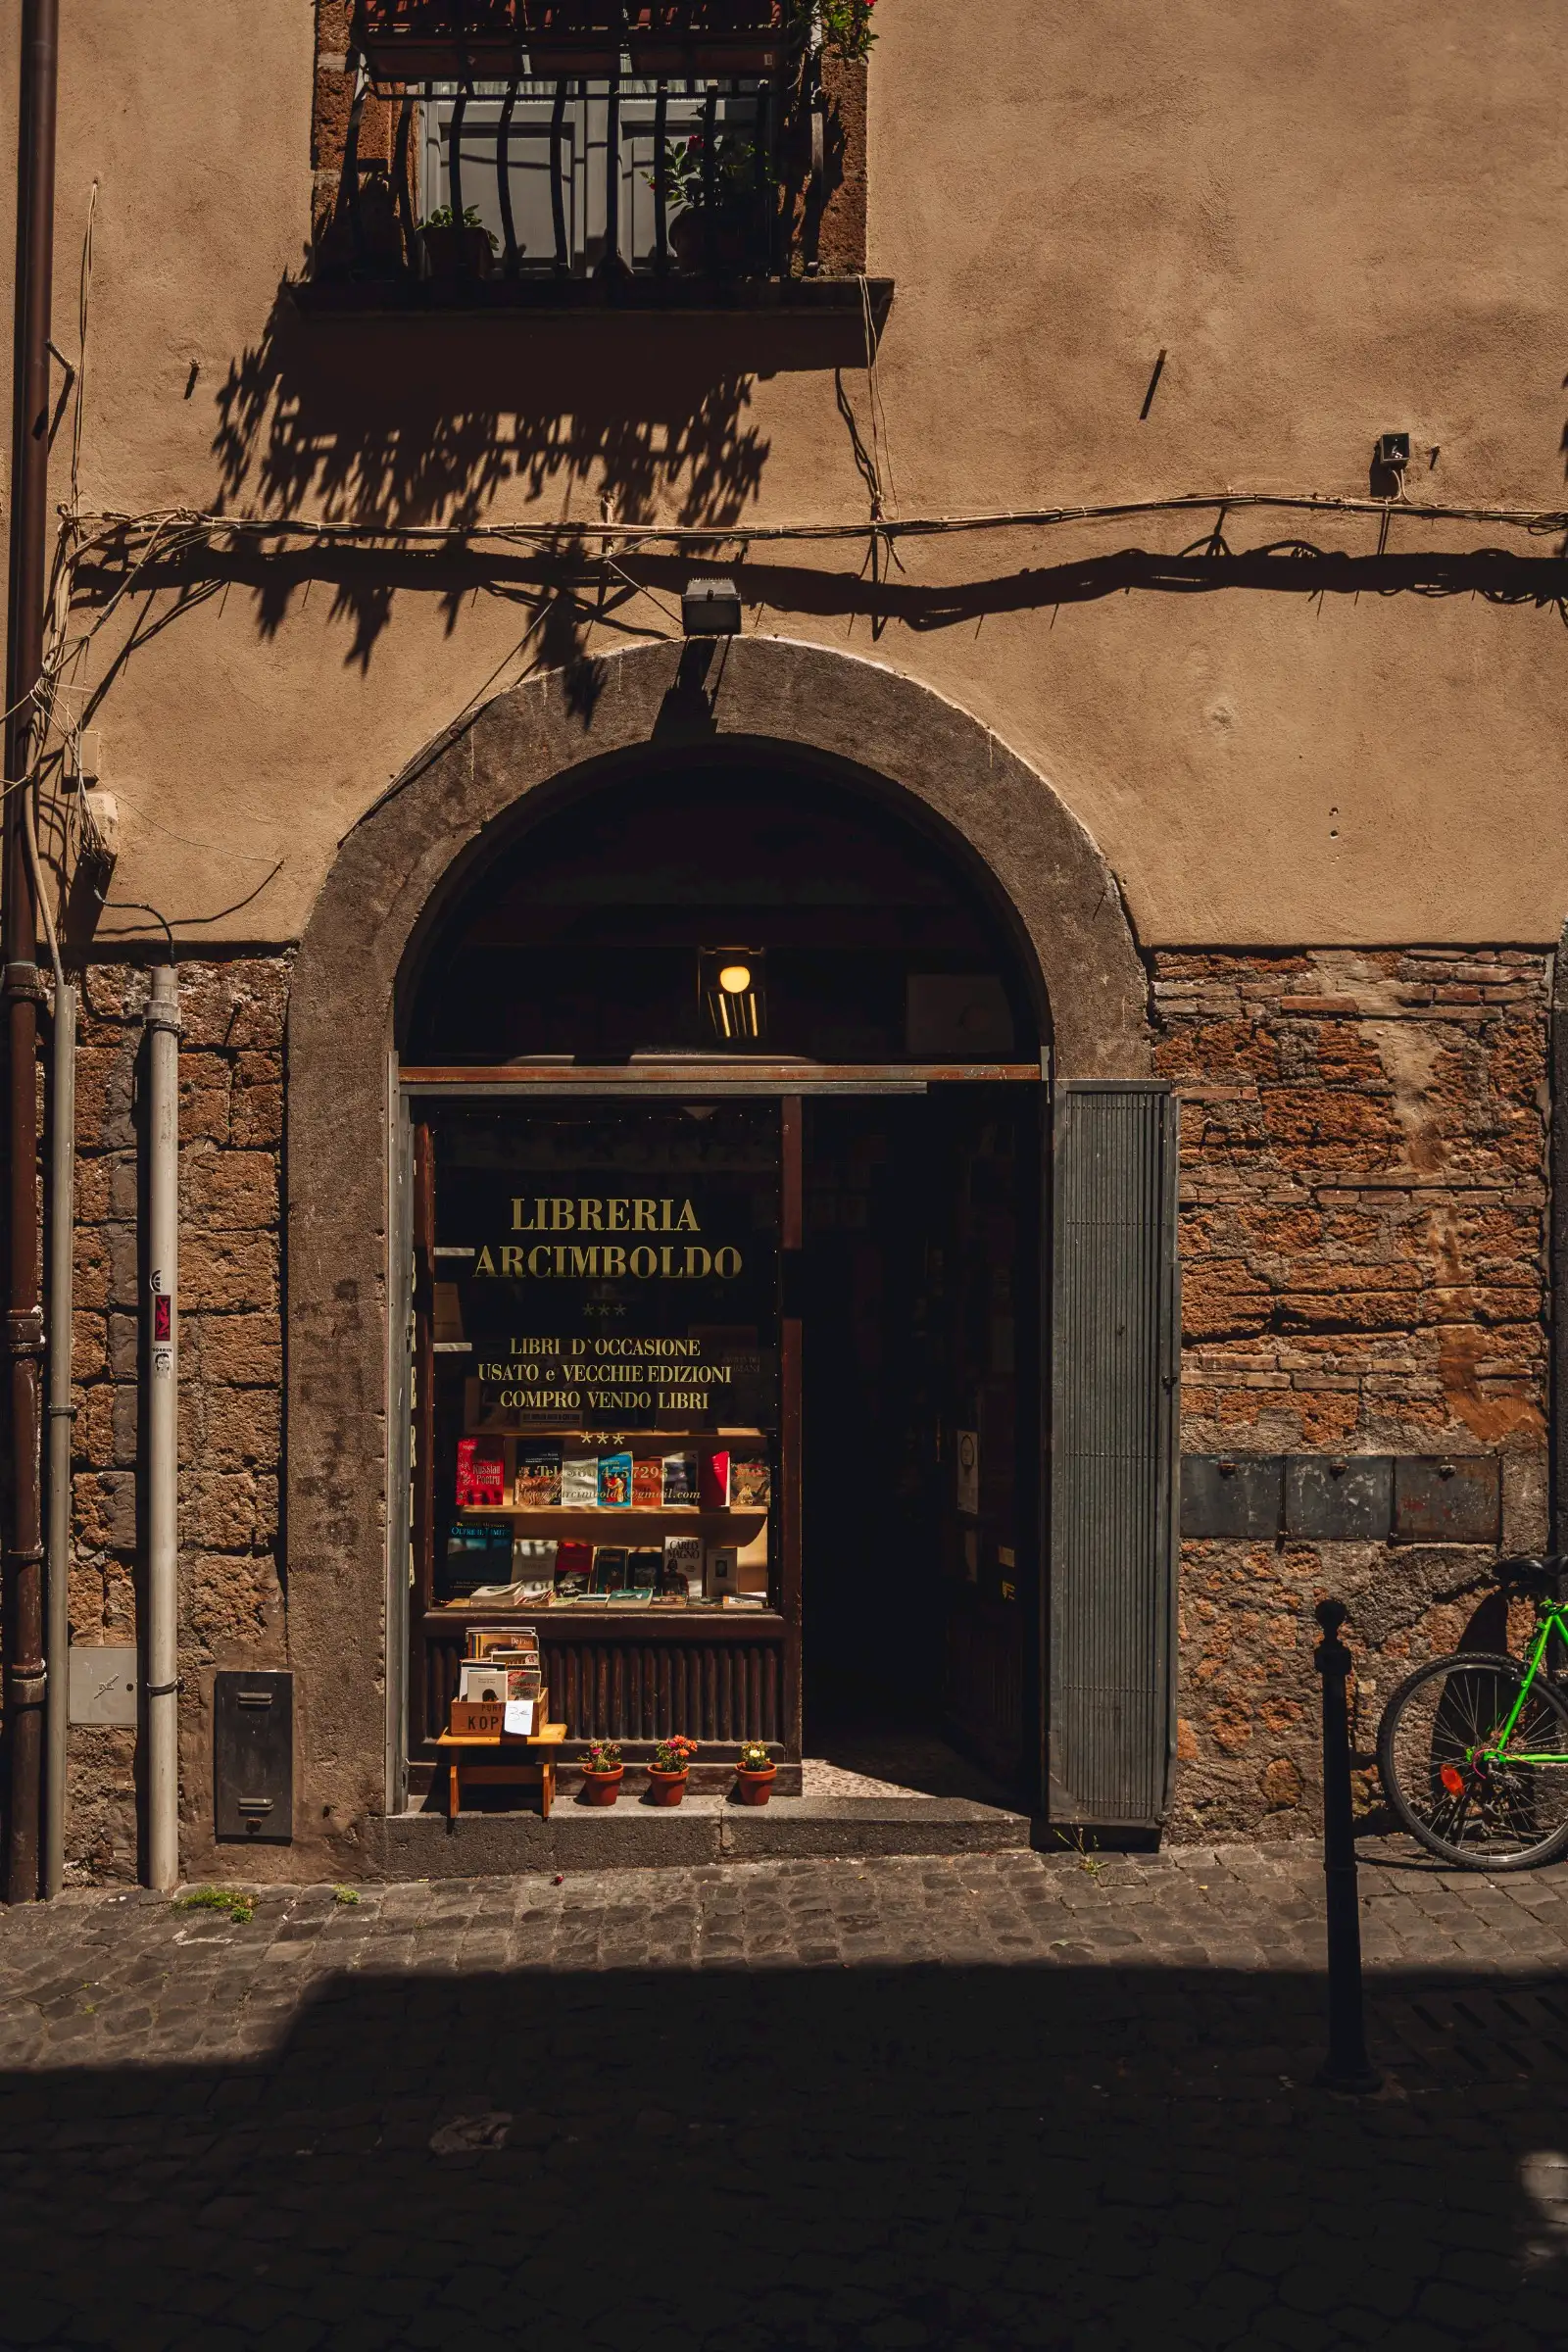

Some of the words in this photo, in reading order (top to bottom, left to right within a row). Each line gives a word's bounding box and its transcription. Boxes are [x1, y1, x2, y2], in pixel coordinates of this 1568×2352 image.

[510, 1198, 701, 1232] LIBRERIA
[471, 1245, 743, 1279] ARCIMBOLDO
[510, 1338, 561, 1355] LIBRI
[477, 1363, 539, 1382] USATO
[545, 1369, 556, 1382] e
[562, 1364, 644, 1383] VECCHIE
[647, 1365, 732, 1384] EDIZIONI
[500, 1390, 581, 1408] COMPRO
[587, 1391, 652, 1409] VENDO
[658, 1392, 710, 1409] LIBRI
[472, 1464, 501, 1475] Russian
[476, 1474, 501, 1486] Poetry
[667, 1549, 700, 1559] MAGNO
[669, 1541, 699, 1550] CARLO
